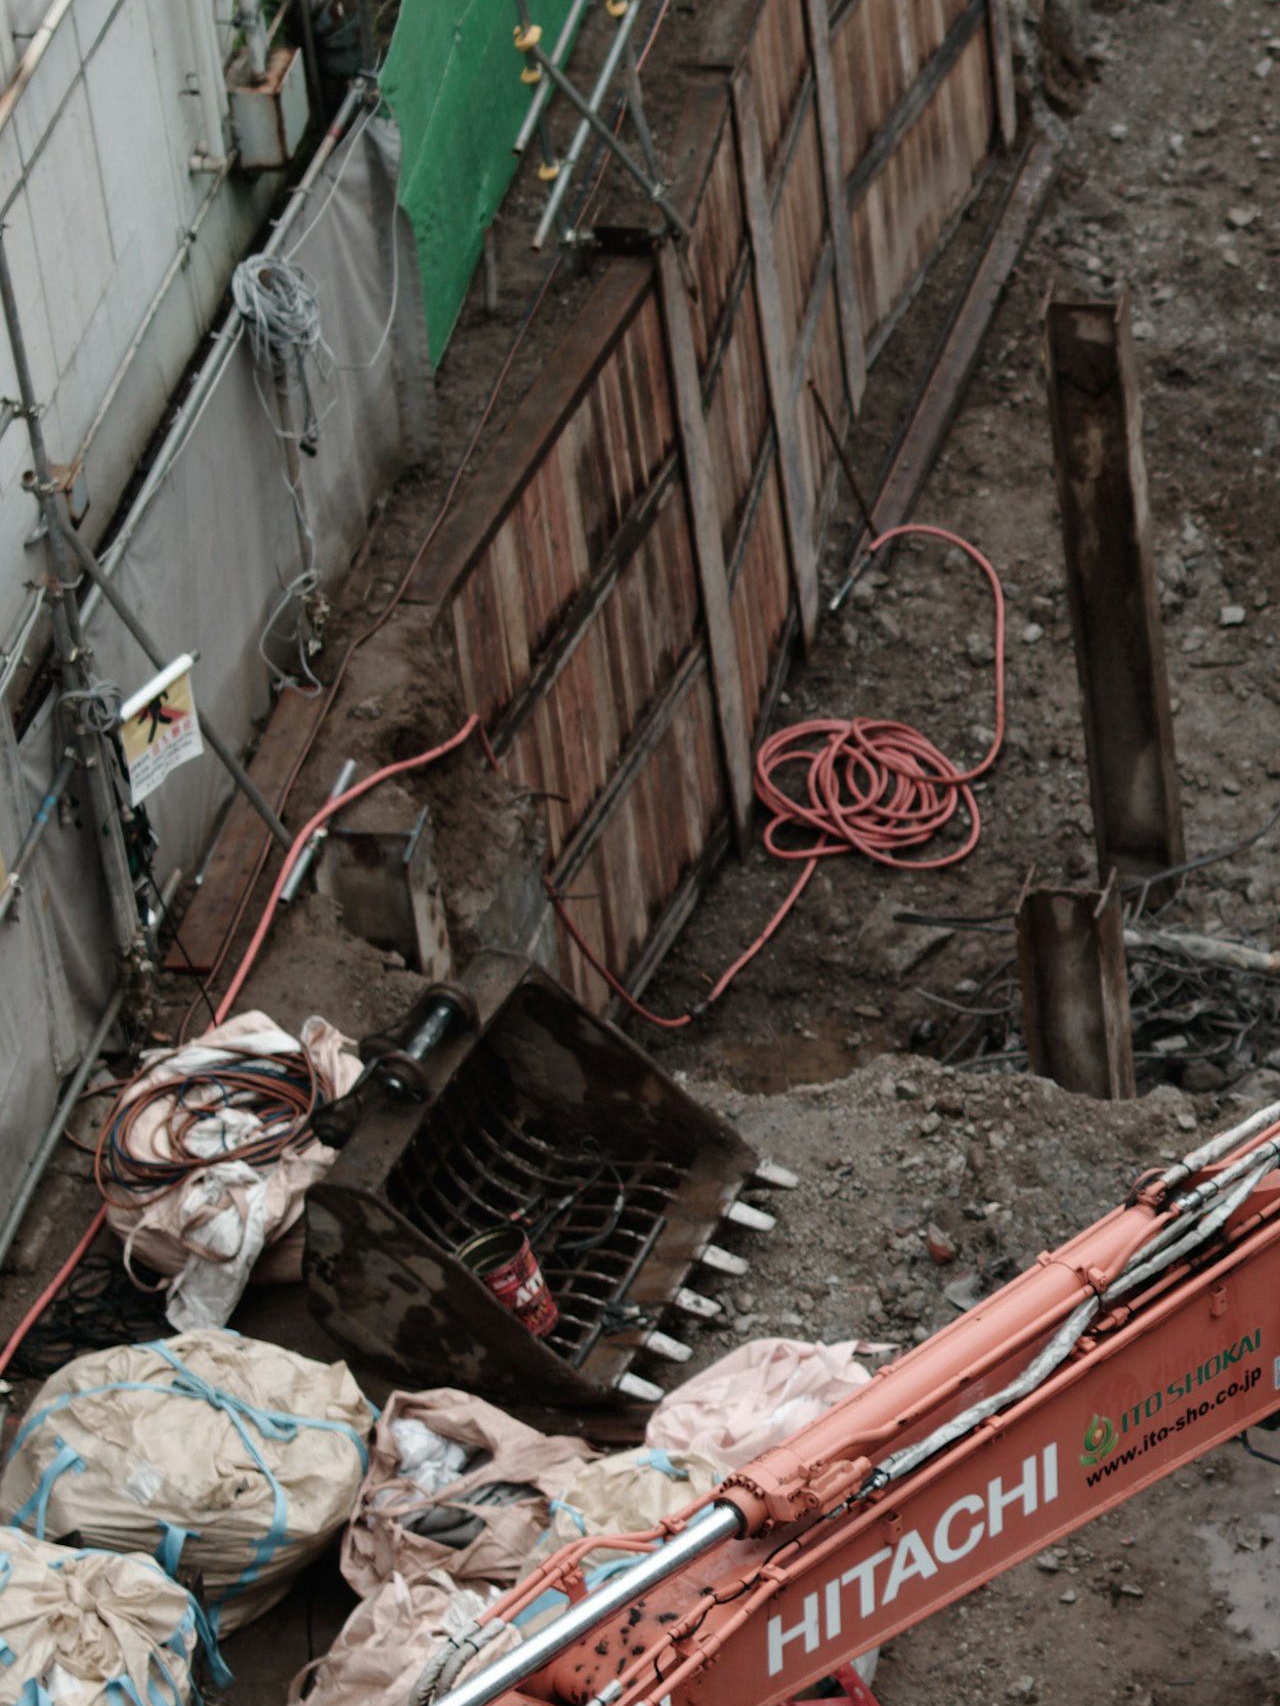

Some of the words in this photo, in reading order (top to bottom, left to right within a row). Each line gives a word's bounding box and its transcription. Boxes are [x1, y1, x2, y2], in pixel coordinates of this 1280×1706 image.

[1085, 1366, 1262, 1488] www.ito-sho.co.jp
[1121, 1390, 1163, 1434] ITO
[1166, 1328, 1262, 1405] SHOKAI
[766, 1442, 1059, 1678] HITACHI
